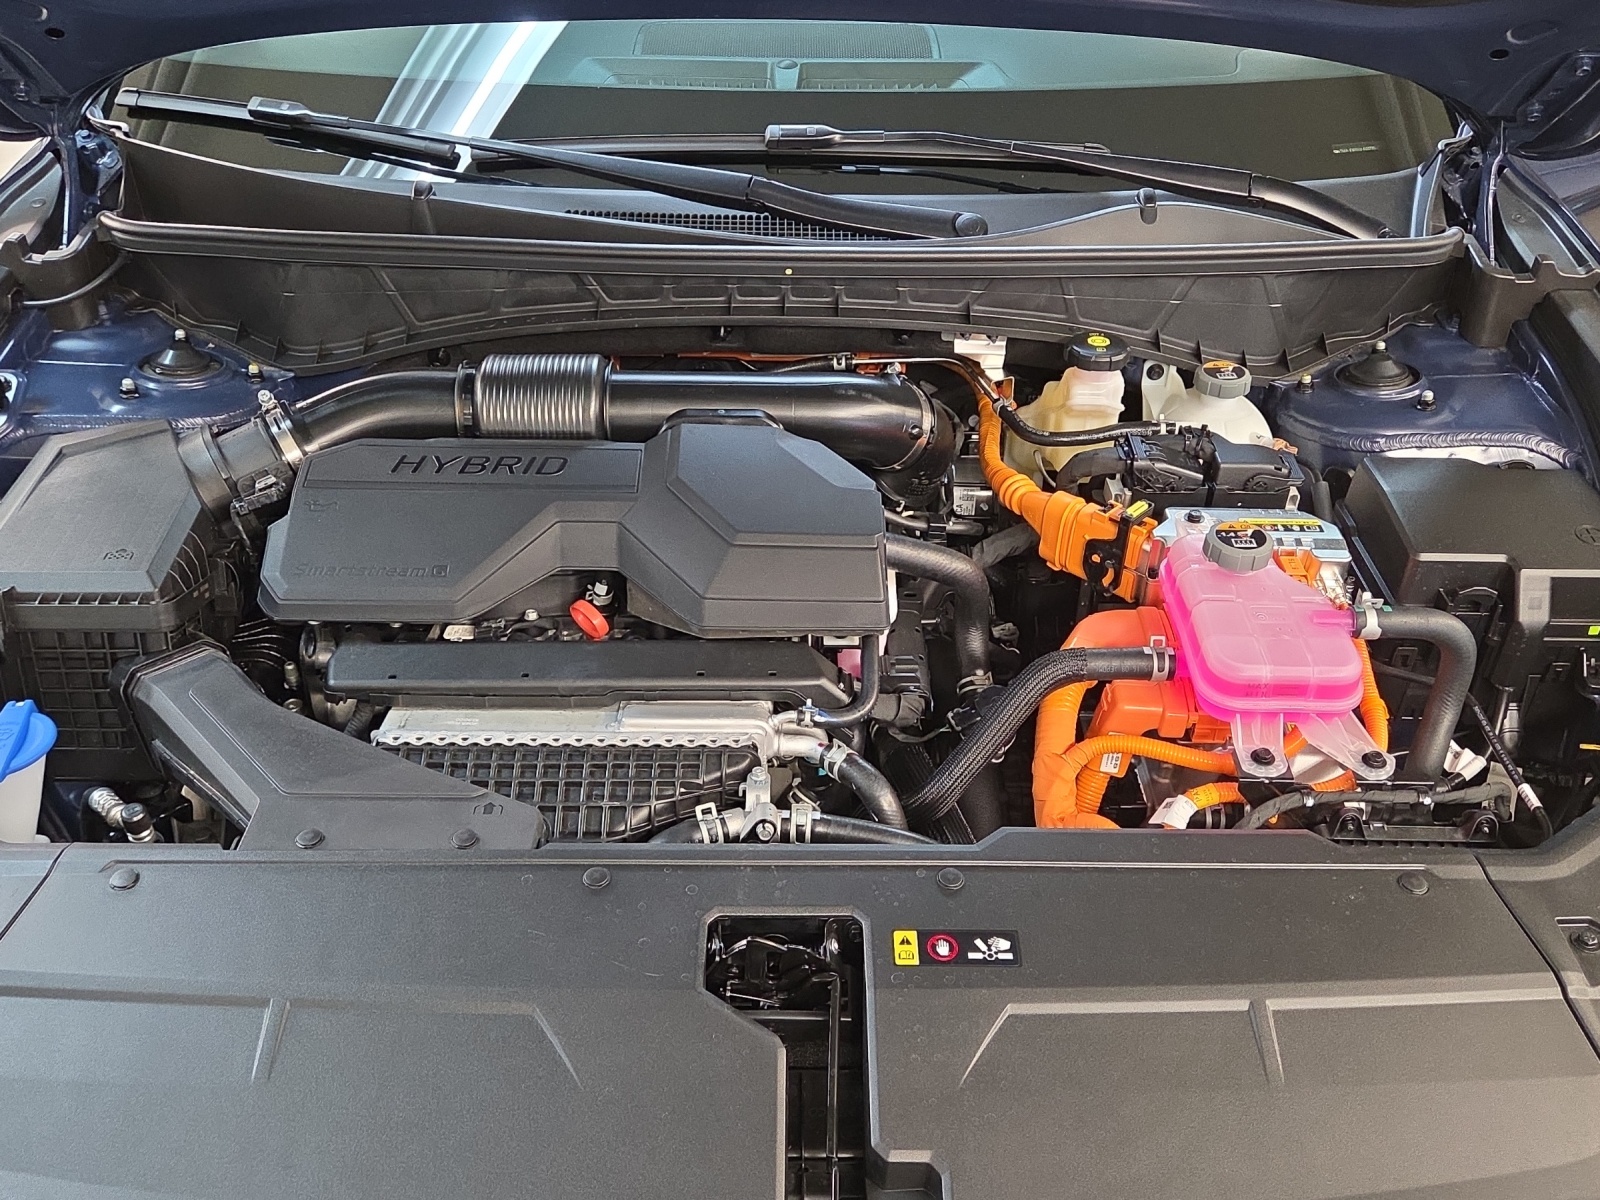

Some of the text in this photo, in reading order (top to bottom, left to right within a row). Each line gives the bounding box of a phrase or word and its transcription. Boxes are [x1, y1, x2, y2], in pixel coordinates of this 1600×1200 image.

[389, 454, 569, 476] HYBRID
[292, 562, 429, 577] Smartstream
[1247, 682, 1270, 690] MAX
